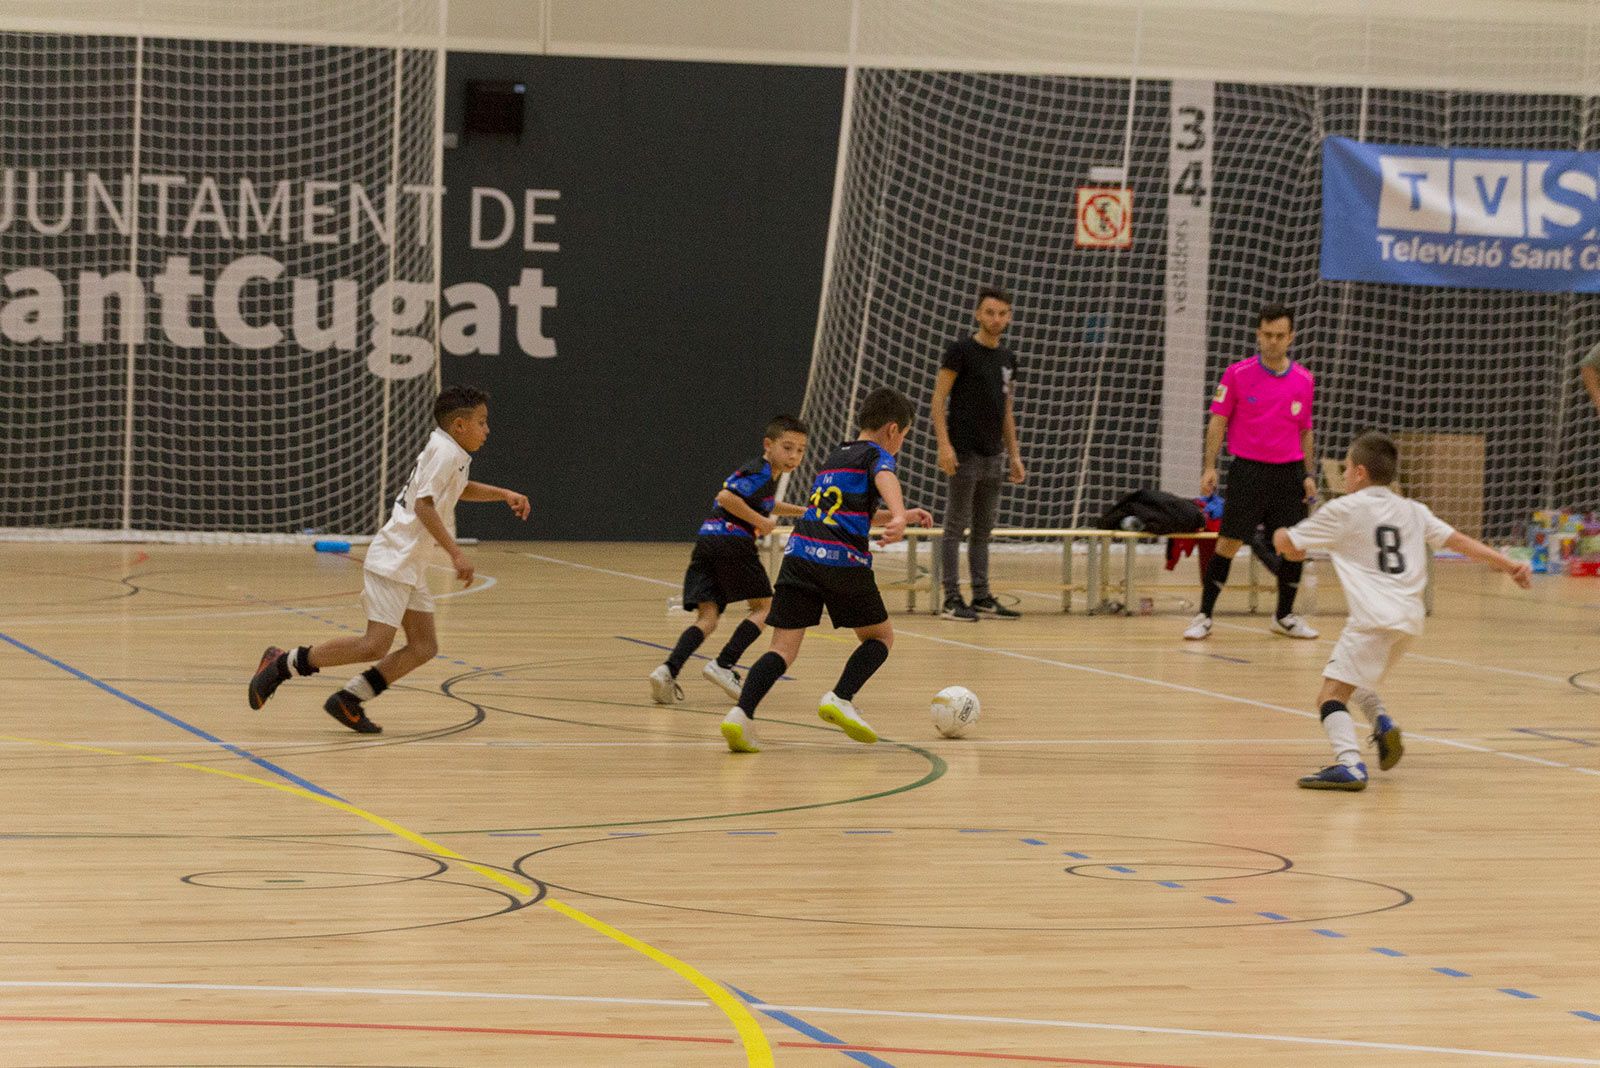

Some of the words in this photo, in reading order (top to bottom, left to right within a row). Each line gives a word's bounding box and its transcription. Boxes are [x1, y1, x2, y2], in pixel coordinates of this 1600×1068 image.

[1176, 105, 1206, 151] 3
[1173, 160, 1207, 208] 4
[470, 186, 561, 252] DE
[1377, 234, 1503, 269] Televisió
[1509, 242, 1574, 270] Sant
[0, 255, 558, 379] antCugat
[810, 485, 843, 525] 12
[1375, 525, 1406, 574] 8
